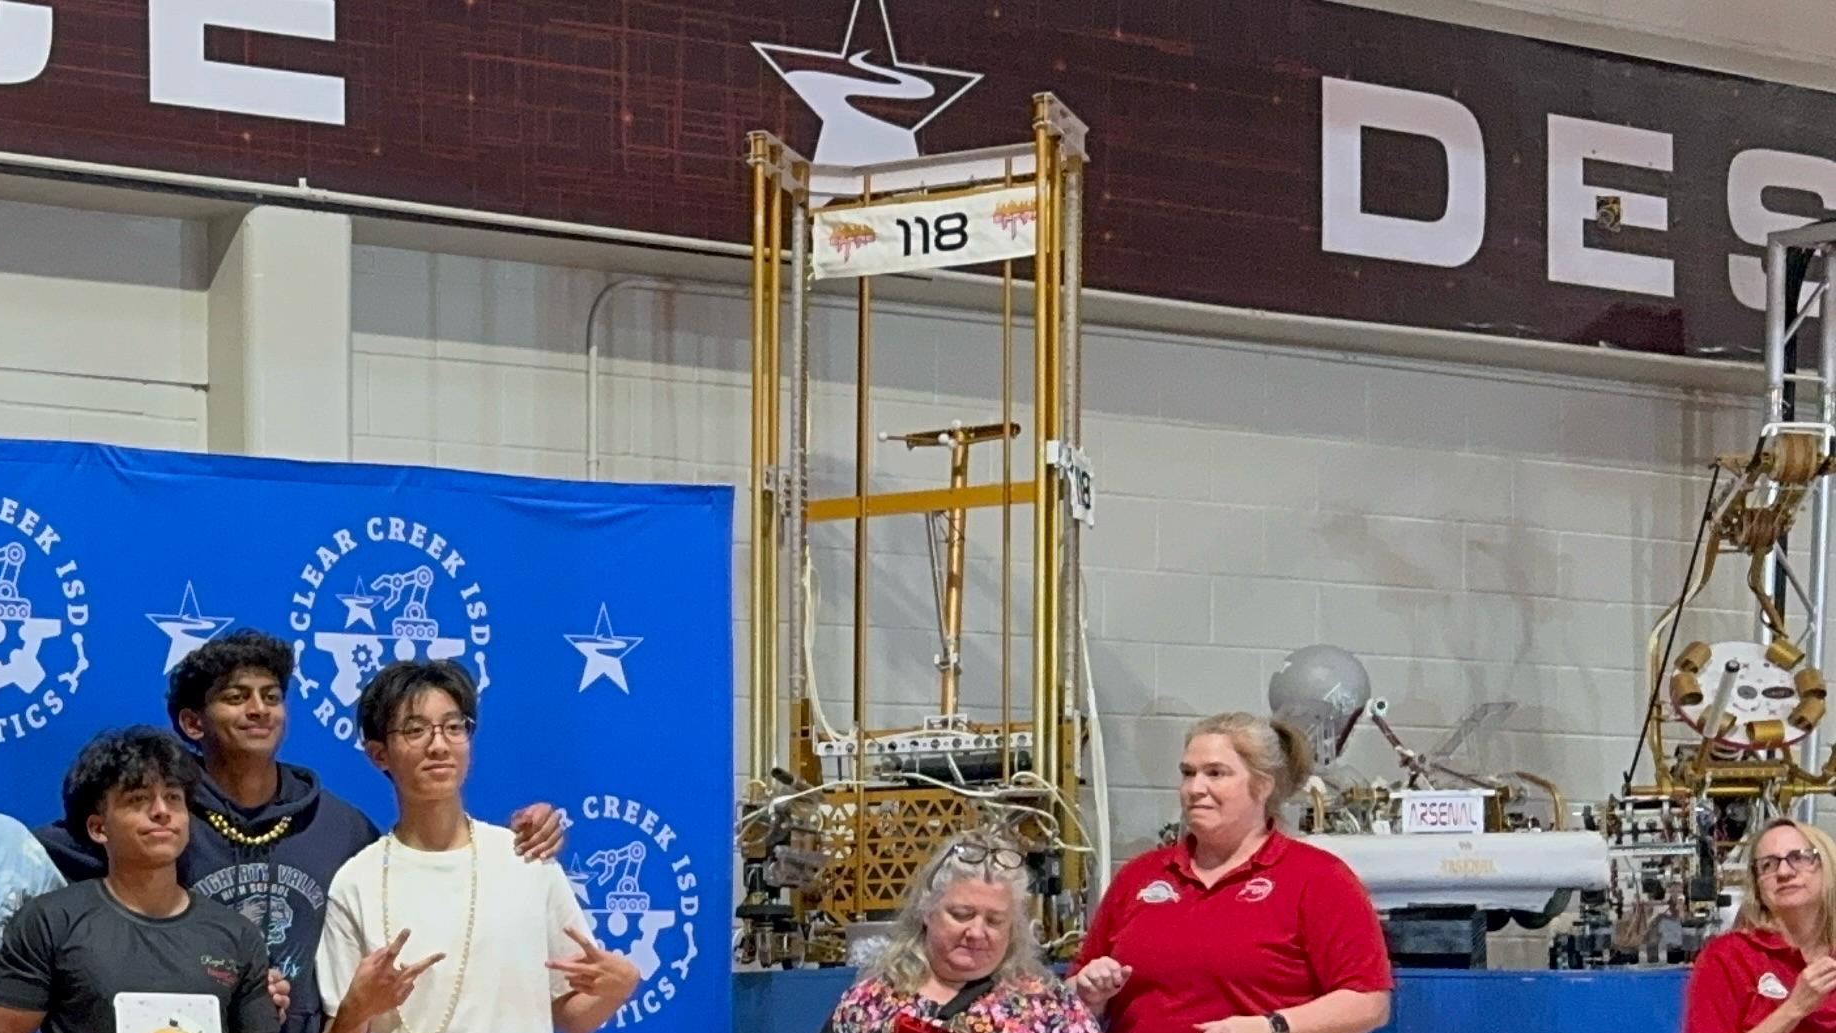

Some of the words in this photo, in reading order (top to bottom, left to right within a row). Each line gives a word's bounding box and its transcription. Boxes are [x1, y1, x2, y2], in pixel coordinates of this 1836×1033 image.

[896, 211, 968, 256] 118
[55, 559, 89, 626] ISD
[290, 528, 358, 632] CLEAR
[367, 516, 466, 579] CREEK
[460, 582, 490, 646] ISD
[1409, 802, 1477, 826] ARSENAL
[583, 795, 678, 852] CREEK
[671, 855, 699, 916] ISD
